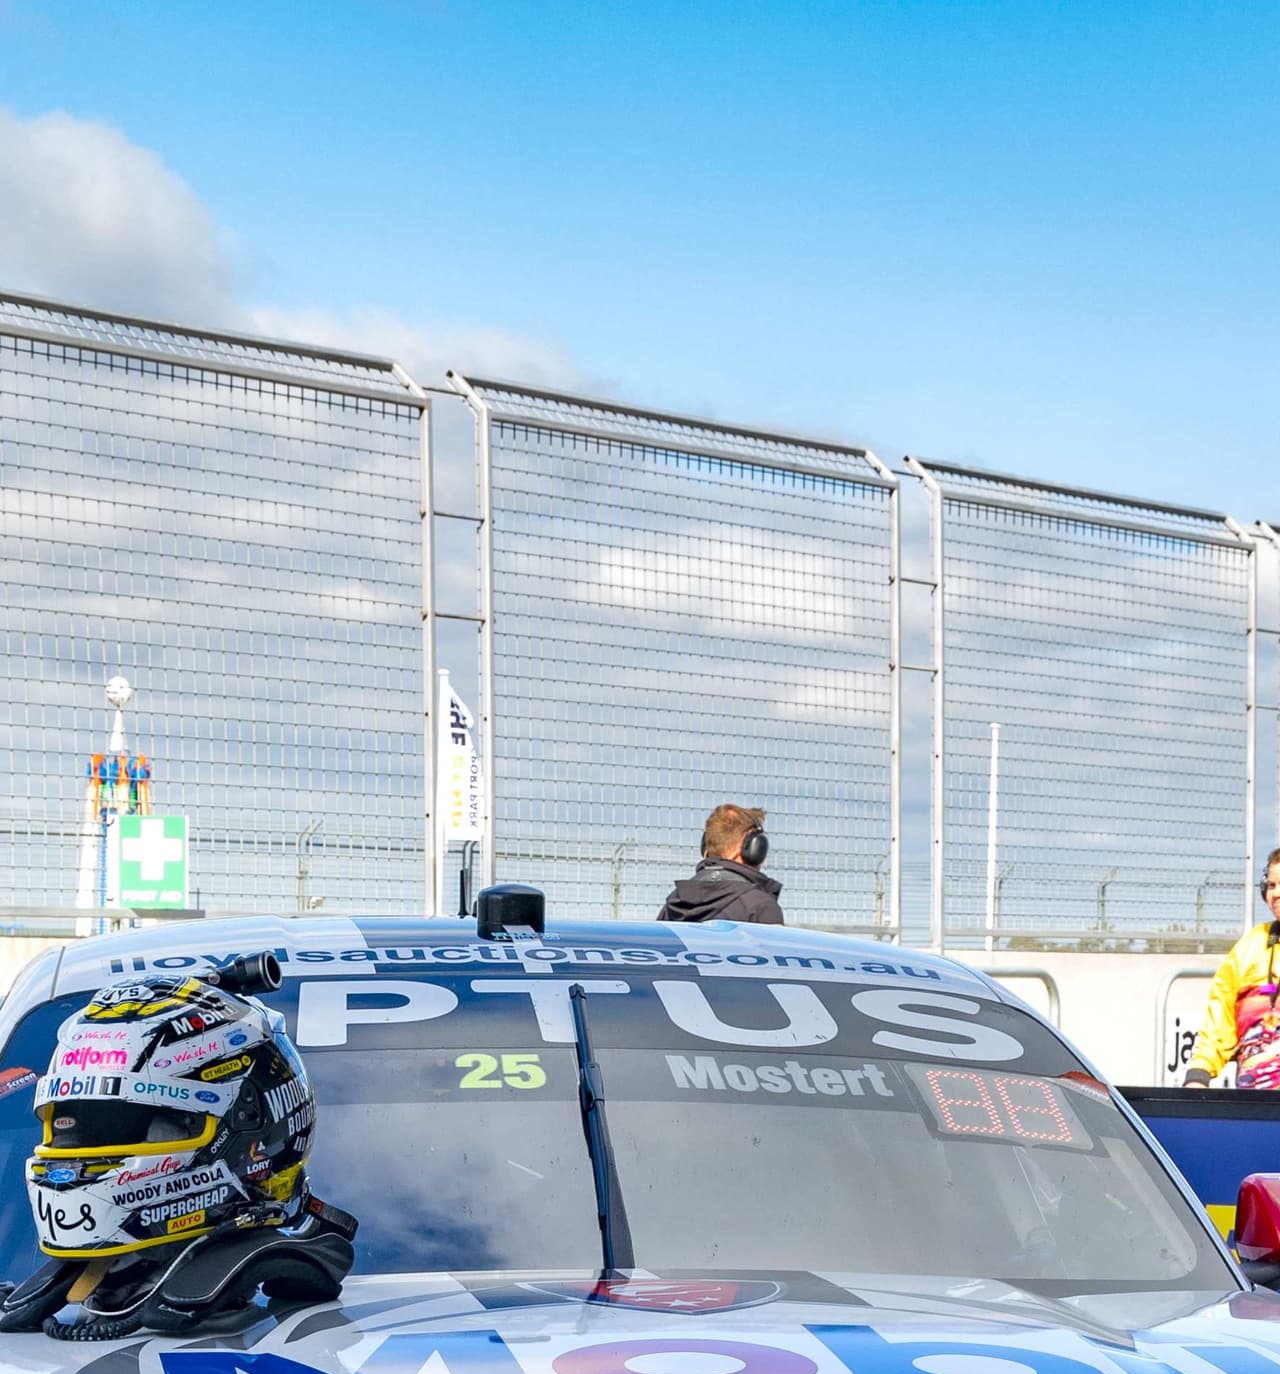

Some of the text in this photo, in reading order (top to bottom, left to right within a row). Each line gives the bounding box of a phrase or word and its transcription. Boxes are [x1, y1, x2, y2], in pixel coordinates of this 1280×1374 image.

[295, 979, 1024, 1062] PTUS
[61, 1046, 128, 1071] rotiform
[6, 1072, 37, 1089] Screen
[455, 1053, 547, 1091] 25
[664, 1053, 896, 1098] Mostert
[48, 1076, 96, 1099] Mobil
[134, 1082, 190, 1100] OPTUS
[117, 1163, 160, 1187] Chemical
[247, 1159, 270, 1174] LORY
[112, 1184, 163, 1206] WOODY
[165, 1177, 191, 1195] AND
[192, 1167, 224, 1186] COLA
[140, 1185, 229, 1228] SUPERCHEAP
[171, 1213, 202, 1230] AUTO
